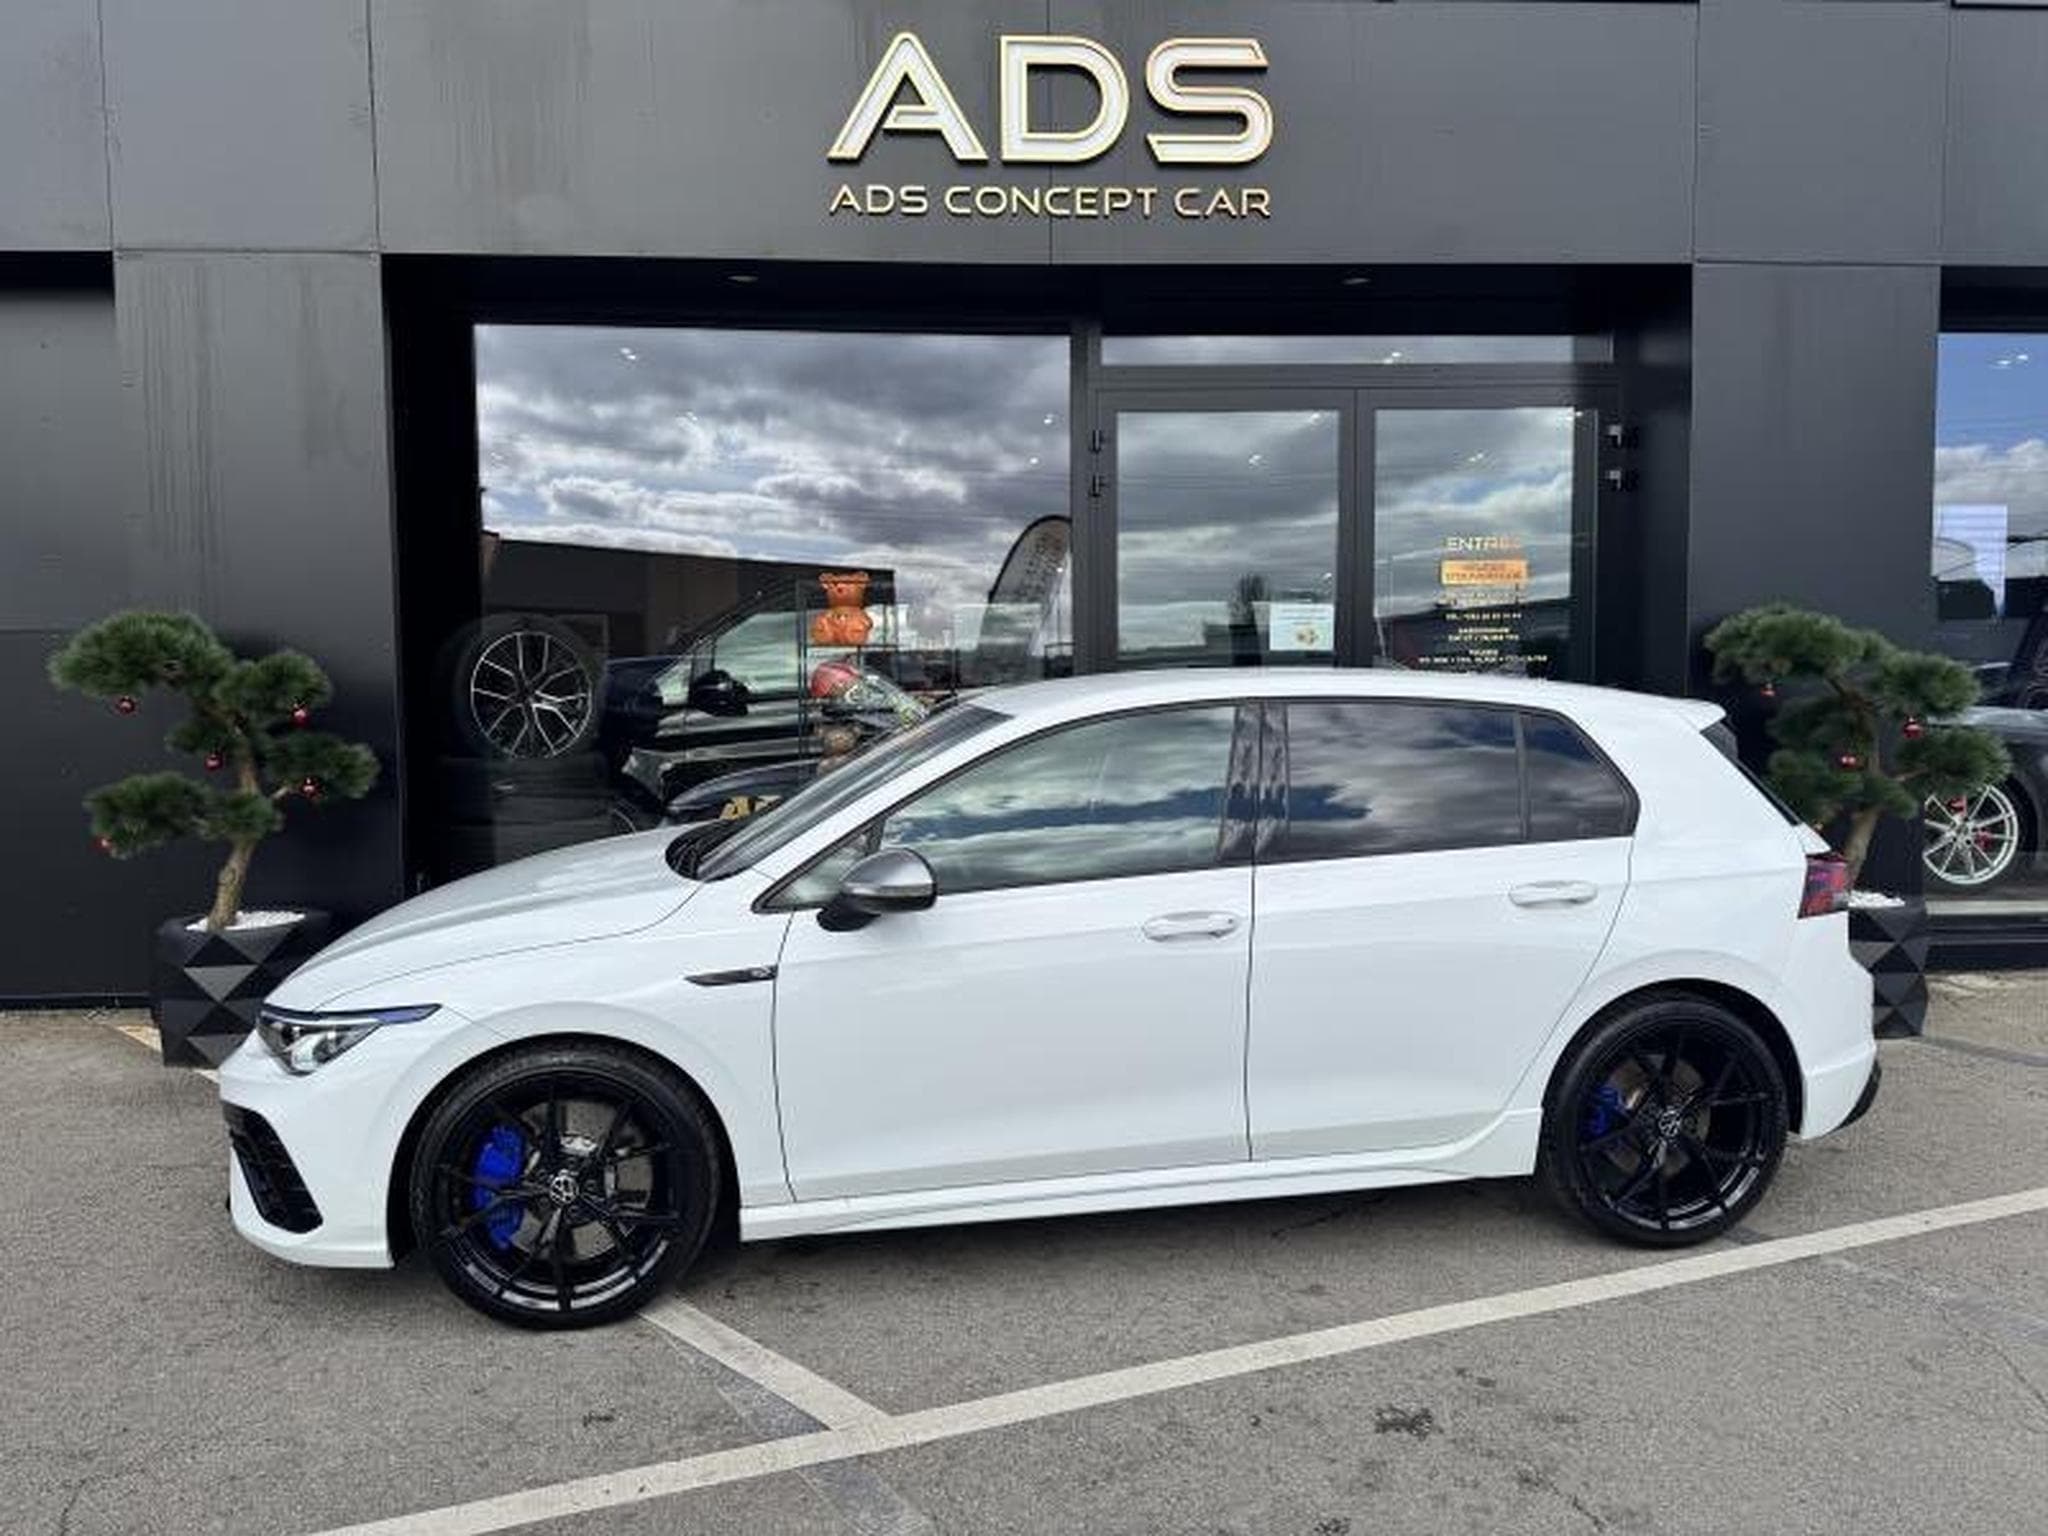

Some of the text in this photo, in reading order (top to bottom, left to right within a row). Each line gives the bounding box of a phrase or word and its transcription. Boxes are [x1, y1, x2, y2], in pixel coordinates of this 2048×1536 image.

[827, 32, 1274, 163] ADS
[829, 185, 1272, 217] ADS CONCEPT CAR
